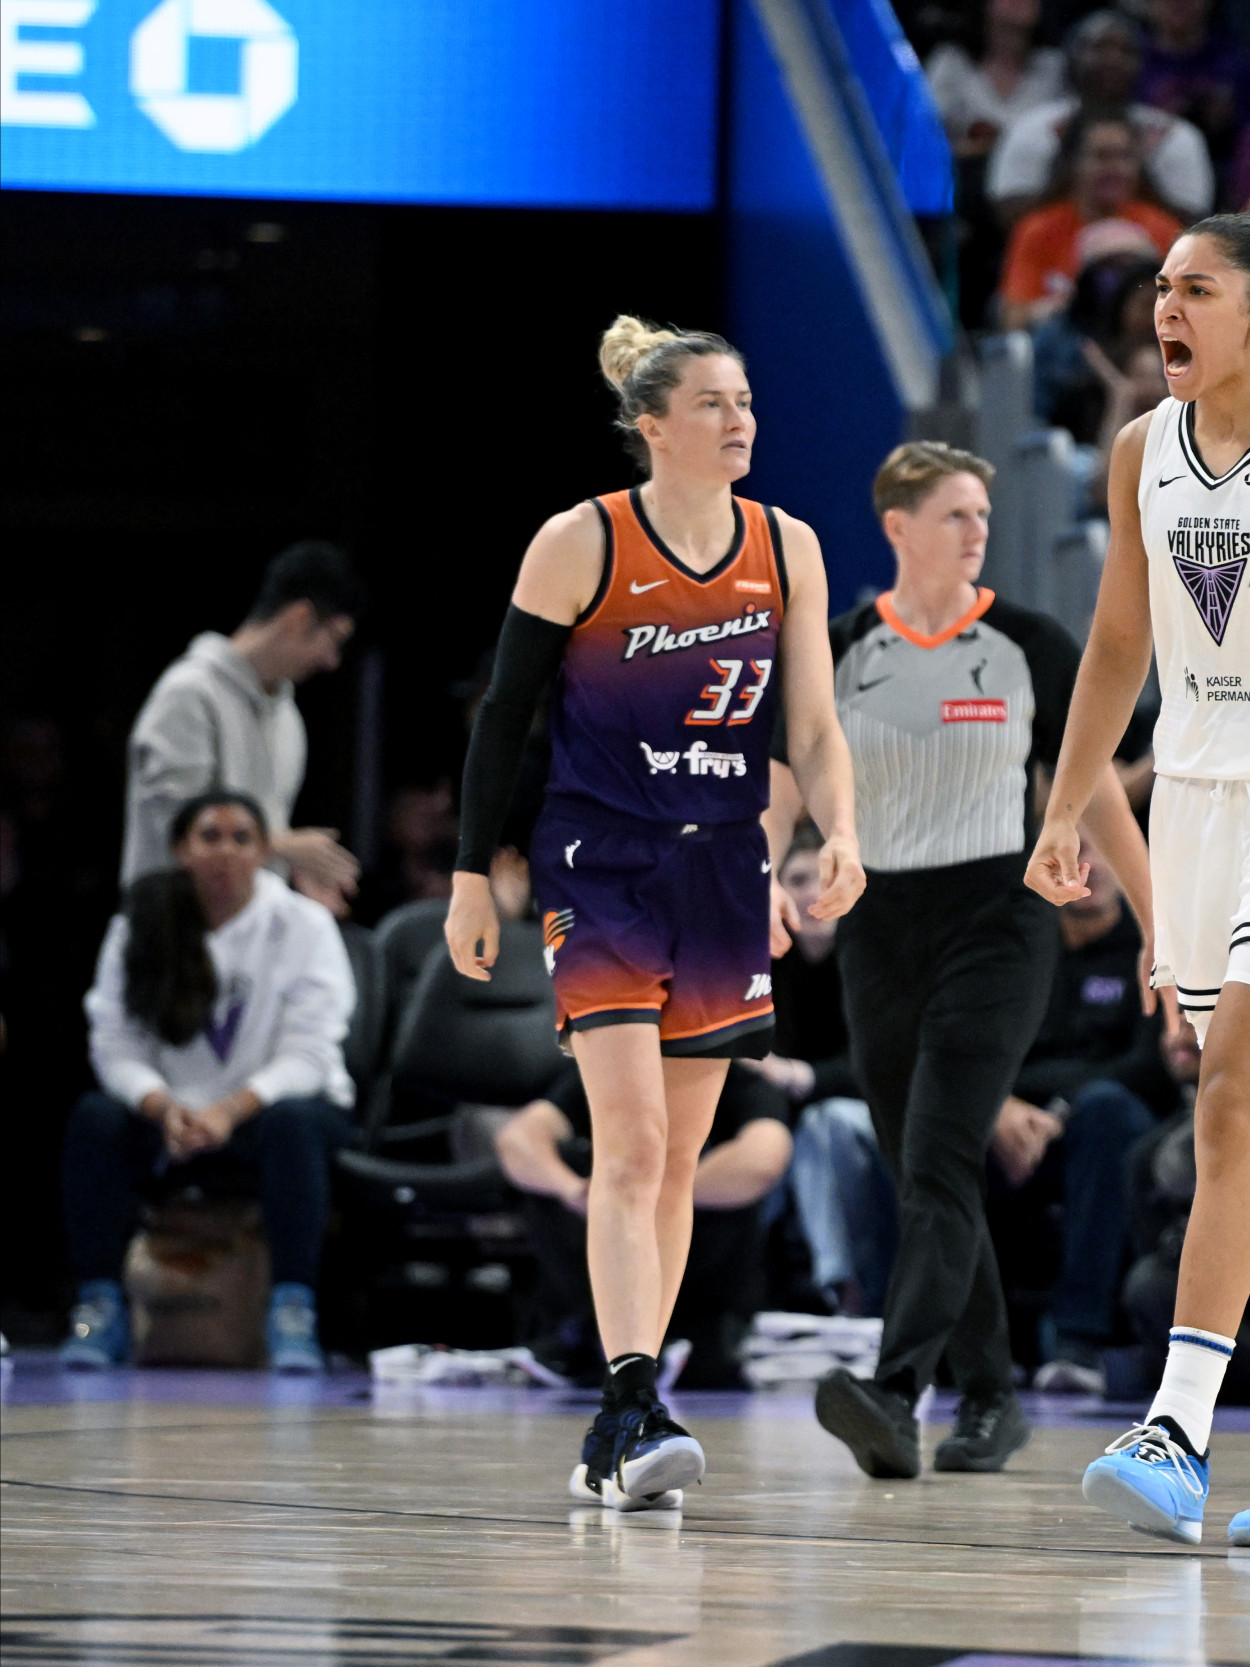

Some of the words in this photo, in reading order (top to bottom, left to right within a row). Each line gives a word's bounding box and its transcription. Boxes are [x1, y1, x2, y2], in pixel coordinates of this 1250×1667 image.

[1177, 516, 1211, 529] GOLDEN
[1213, 518, 1241, 531] STATE
[1167, 530, 1250, 565] VALKYRIES
[623, 603, 773, 661] Phoenix
[685, 657, 772, 726] 33
[1206, 676, 1242, 687] KAISER
[944, 703, 1007, 719] Emirates
[682, 740, 747, 778] fry's
